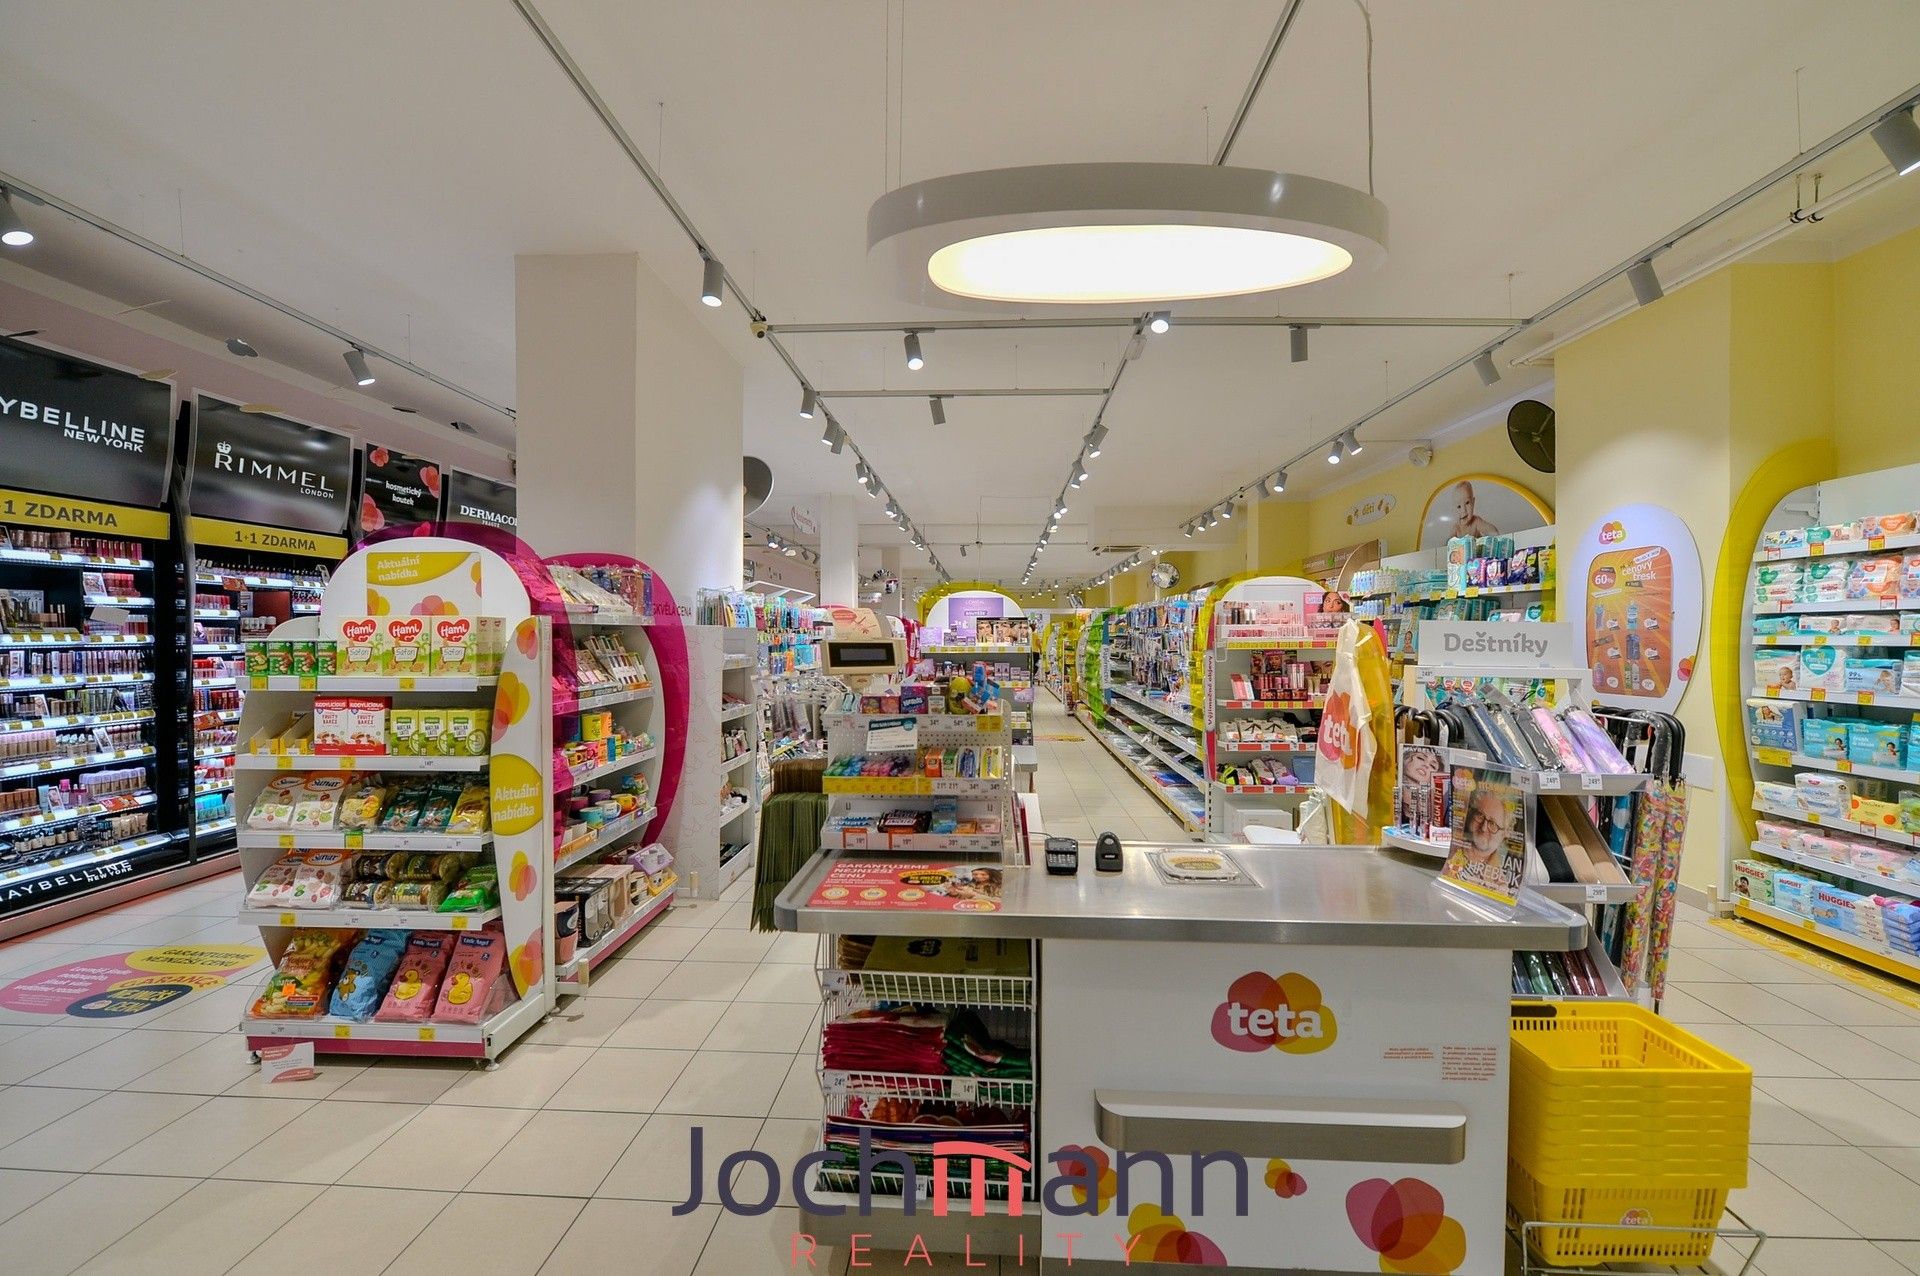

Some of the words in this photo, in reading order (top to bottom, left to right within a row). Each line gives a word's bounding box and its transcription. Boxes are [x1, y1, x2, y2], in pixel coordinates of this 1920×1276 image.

[64, 428, 100, 443] NEW
[102, 436, 143, 452] YORK
[214, 451, 334, 492] RIMMEL
[300, 487, 334, 499] LONDON
[385, 480, 421, 498] kosmetický
[392, 493, 414, 506] koutek
[25, 501, 117, 527] ZDARMA
[261, 533, 316, 551] ZDARMA
[1602, 528, 1624, 541] teta
[376, 554, 421, 570] Aktuální
[378, 568, 419, 583] nabídka
[1443, 631, 1549, 657] Deštníky
[494, 783, 539, 801] Aktuální
[493, 803, 535, 822] nabídka
[0, 859, 131, 901] AYBELLINE
[1735, 864, 1765, 880] HUGGIES
[1818, 892, 1856, 911] HUGGIES
[1227, 1002, 1324, 1038] teta
